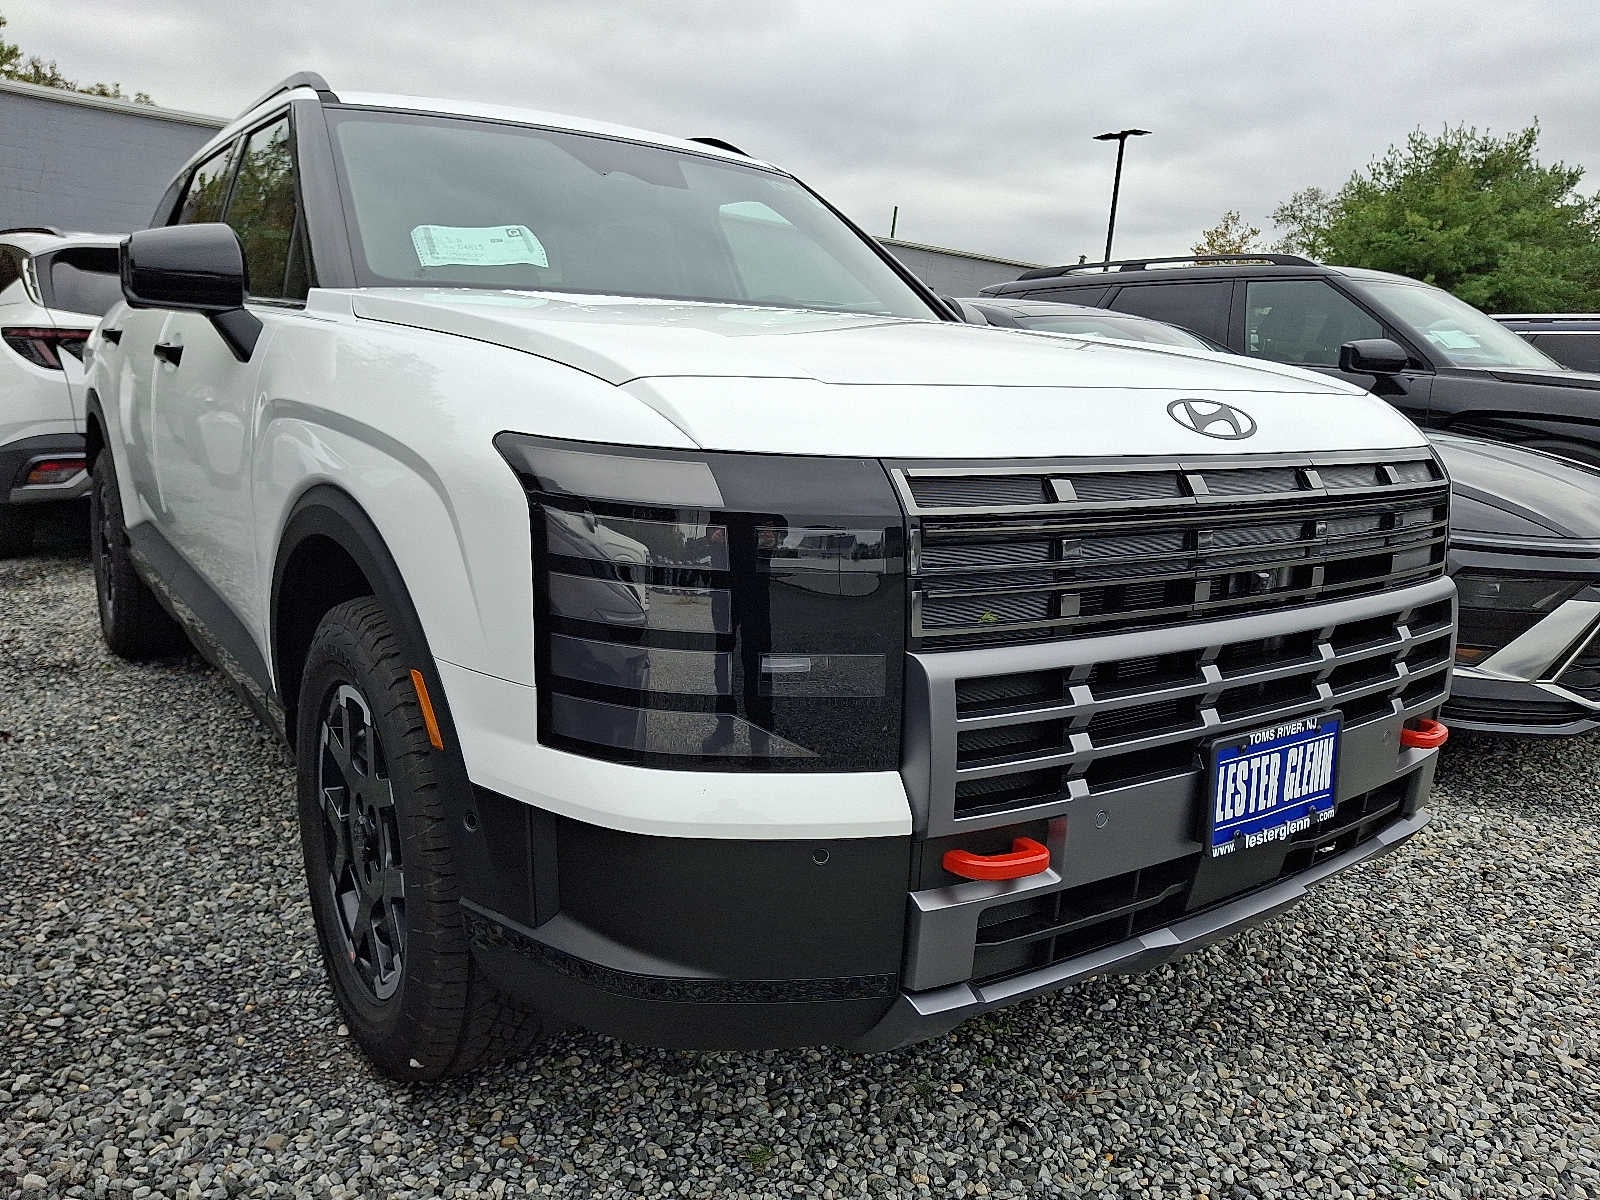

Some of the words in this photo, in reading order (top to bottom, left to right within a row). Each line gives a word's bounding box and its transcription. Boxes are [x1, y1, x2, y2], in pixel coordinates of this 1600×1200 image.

[1250, 730, 1276, 745] TOMS
[1277, 722, 1305, 739] RIVER,
[1307, 718, 1317, 730] NJ
[1215, 752, 1281, 823] LESTER
[1283, 737, 1335, 801] GLENN
[1212, 843, 1236, 858] www.
[1245, 818, 1310, 848] lesterglenn
